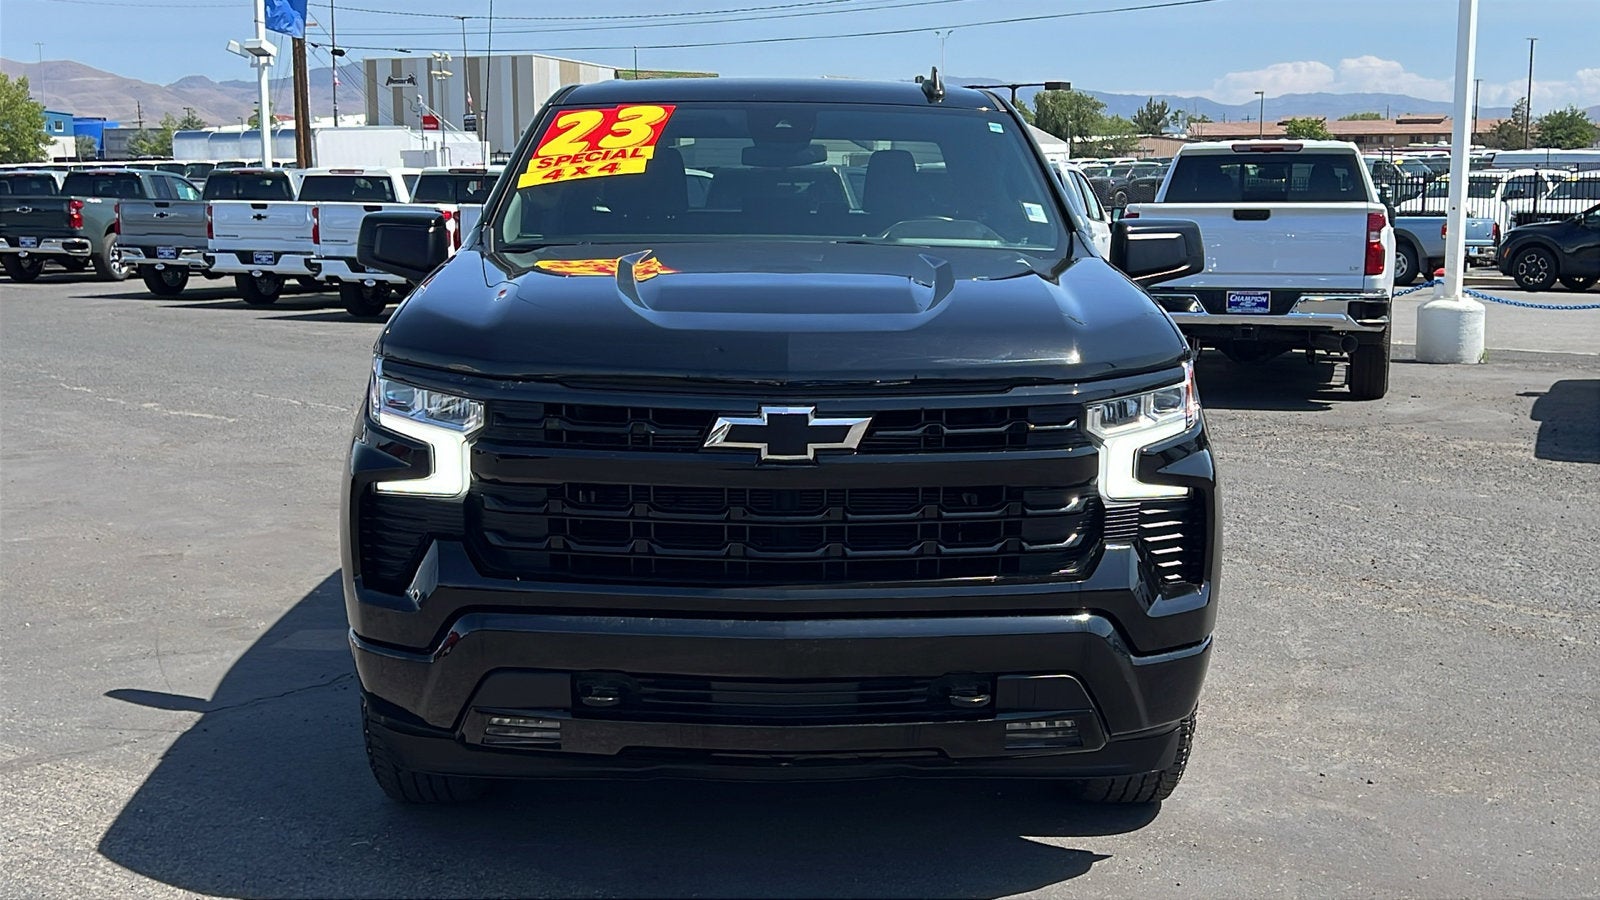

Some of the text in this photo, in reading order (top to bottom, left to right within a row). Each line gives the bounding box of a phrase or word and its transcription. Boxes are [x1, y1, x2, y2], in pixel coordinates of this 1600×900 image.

[538, 105, 668, 157] 23
[537, 147, 644, 169] SPECIAL
[1230, 294, 1268, 303] CHAMPION
